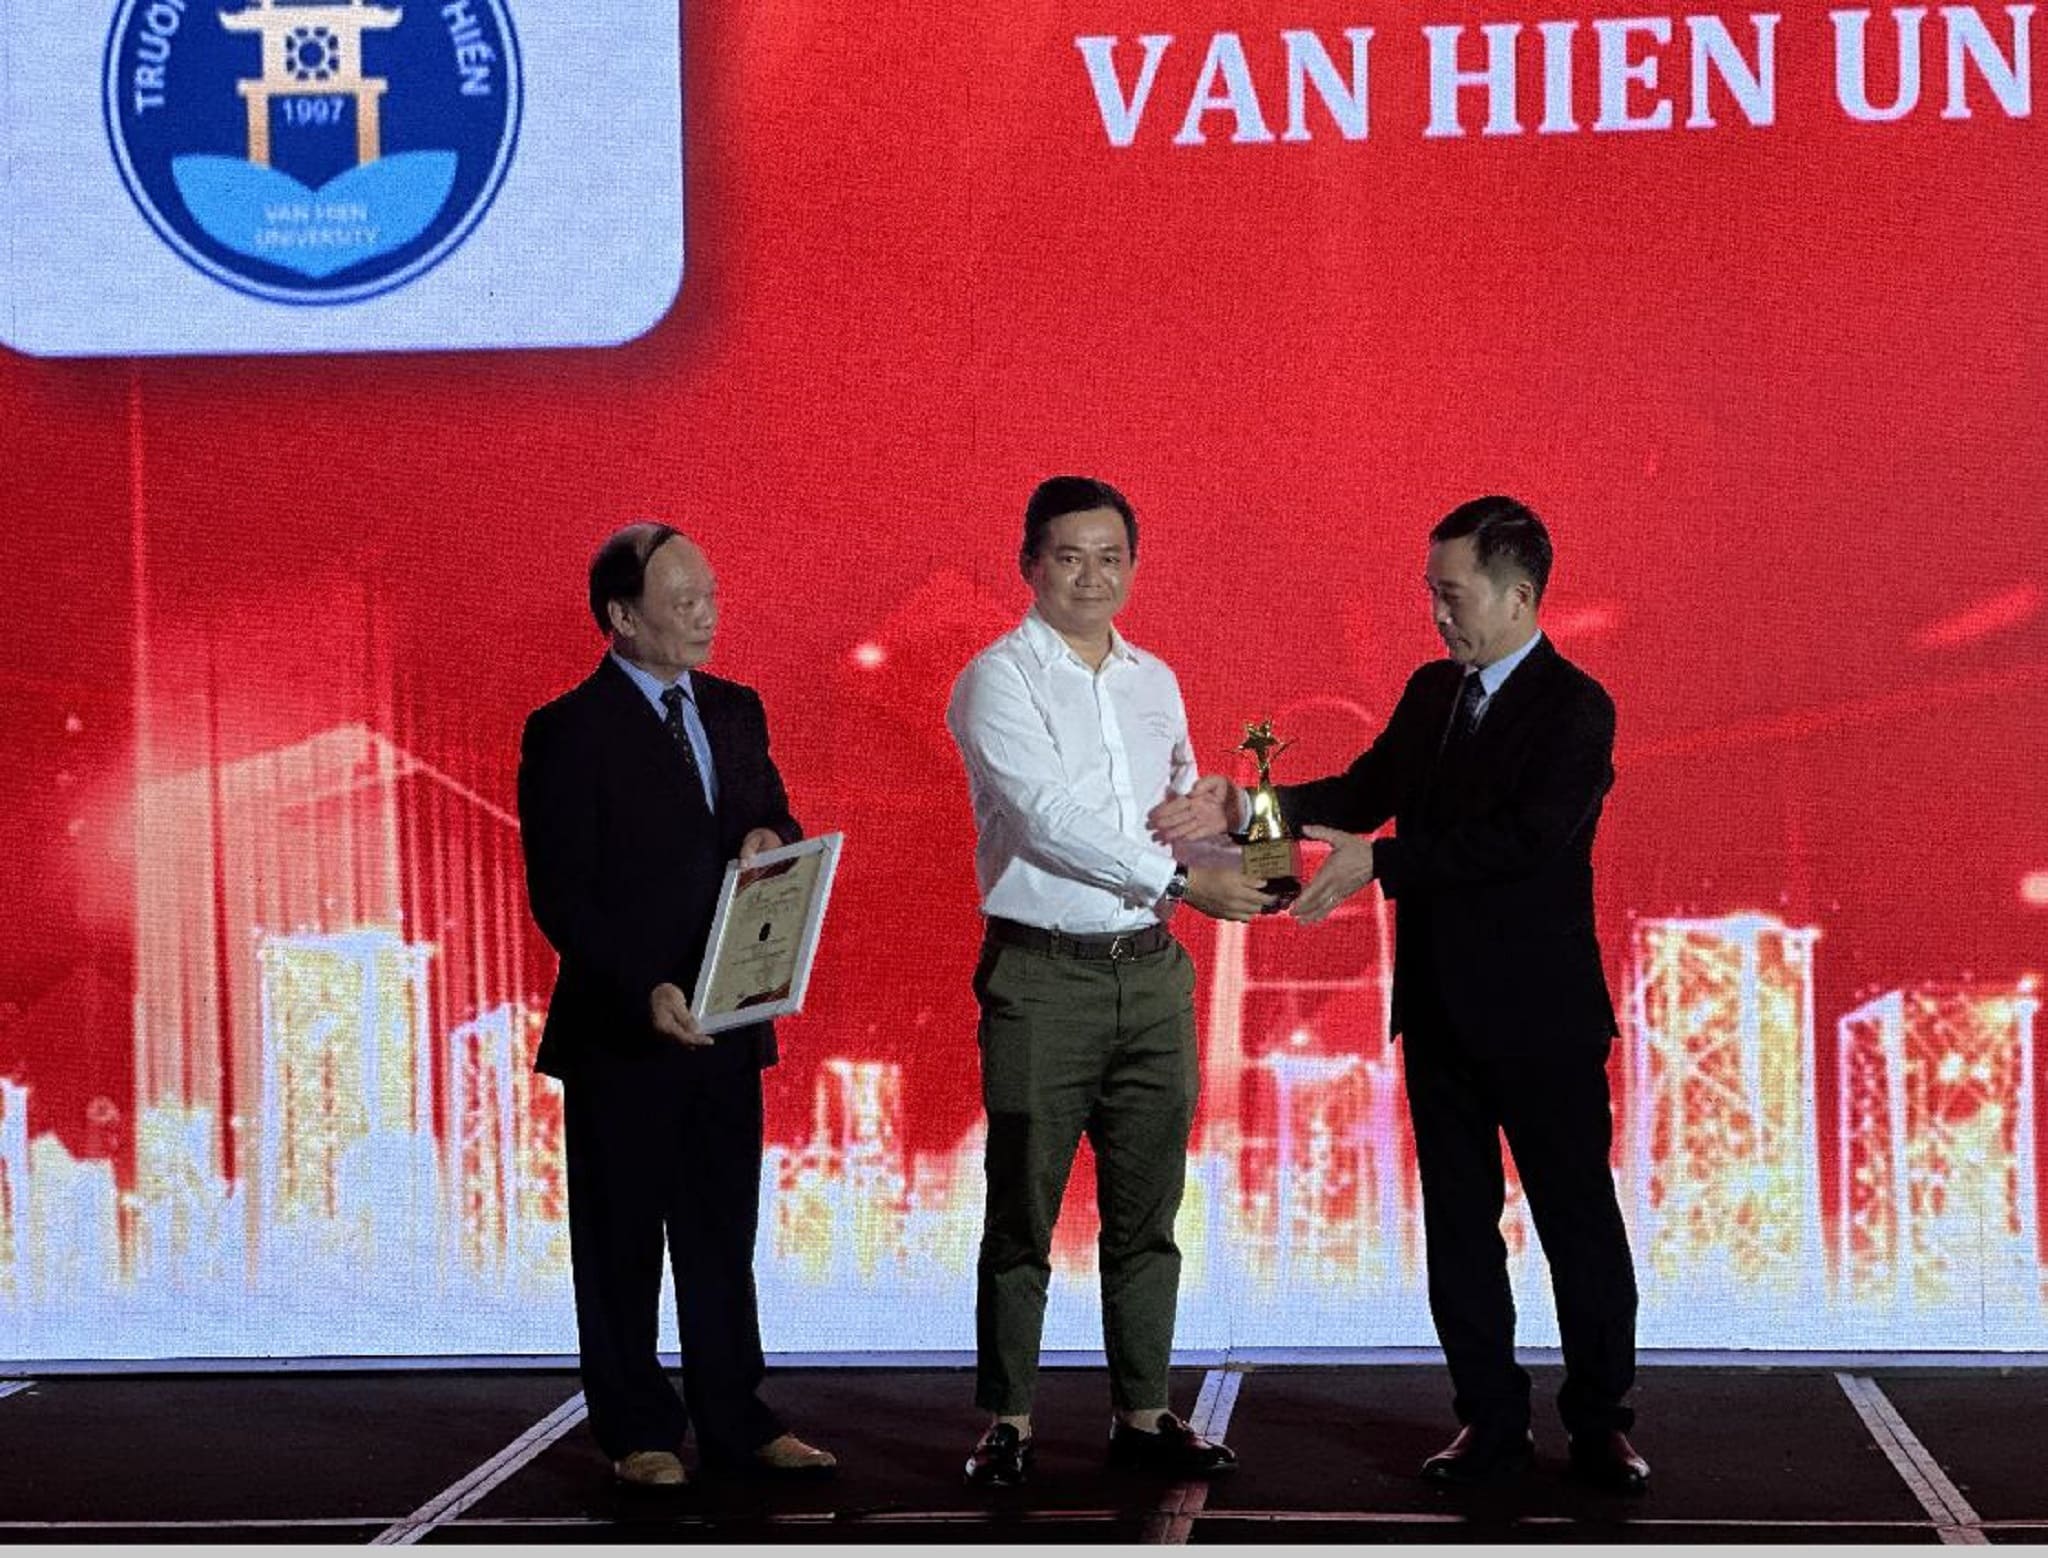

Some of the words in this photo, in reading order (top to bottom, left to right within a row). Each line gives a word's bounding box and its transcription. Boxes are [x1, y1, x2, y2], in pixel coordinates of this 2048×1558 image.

[282, 97, 344, 125] 1997
[1075, 27, 1375, 147] VAN
[1420, 13, 1781, 138] HIEN
[1829, 4, 2037, 122] UN
